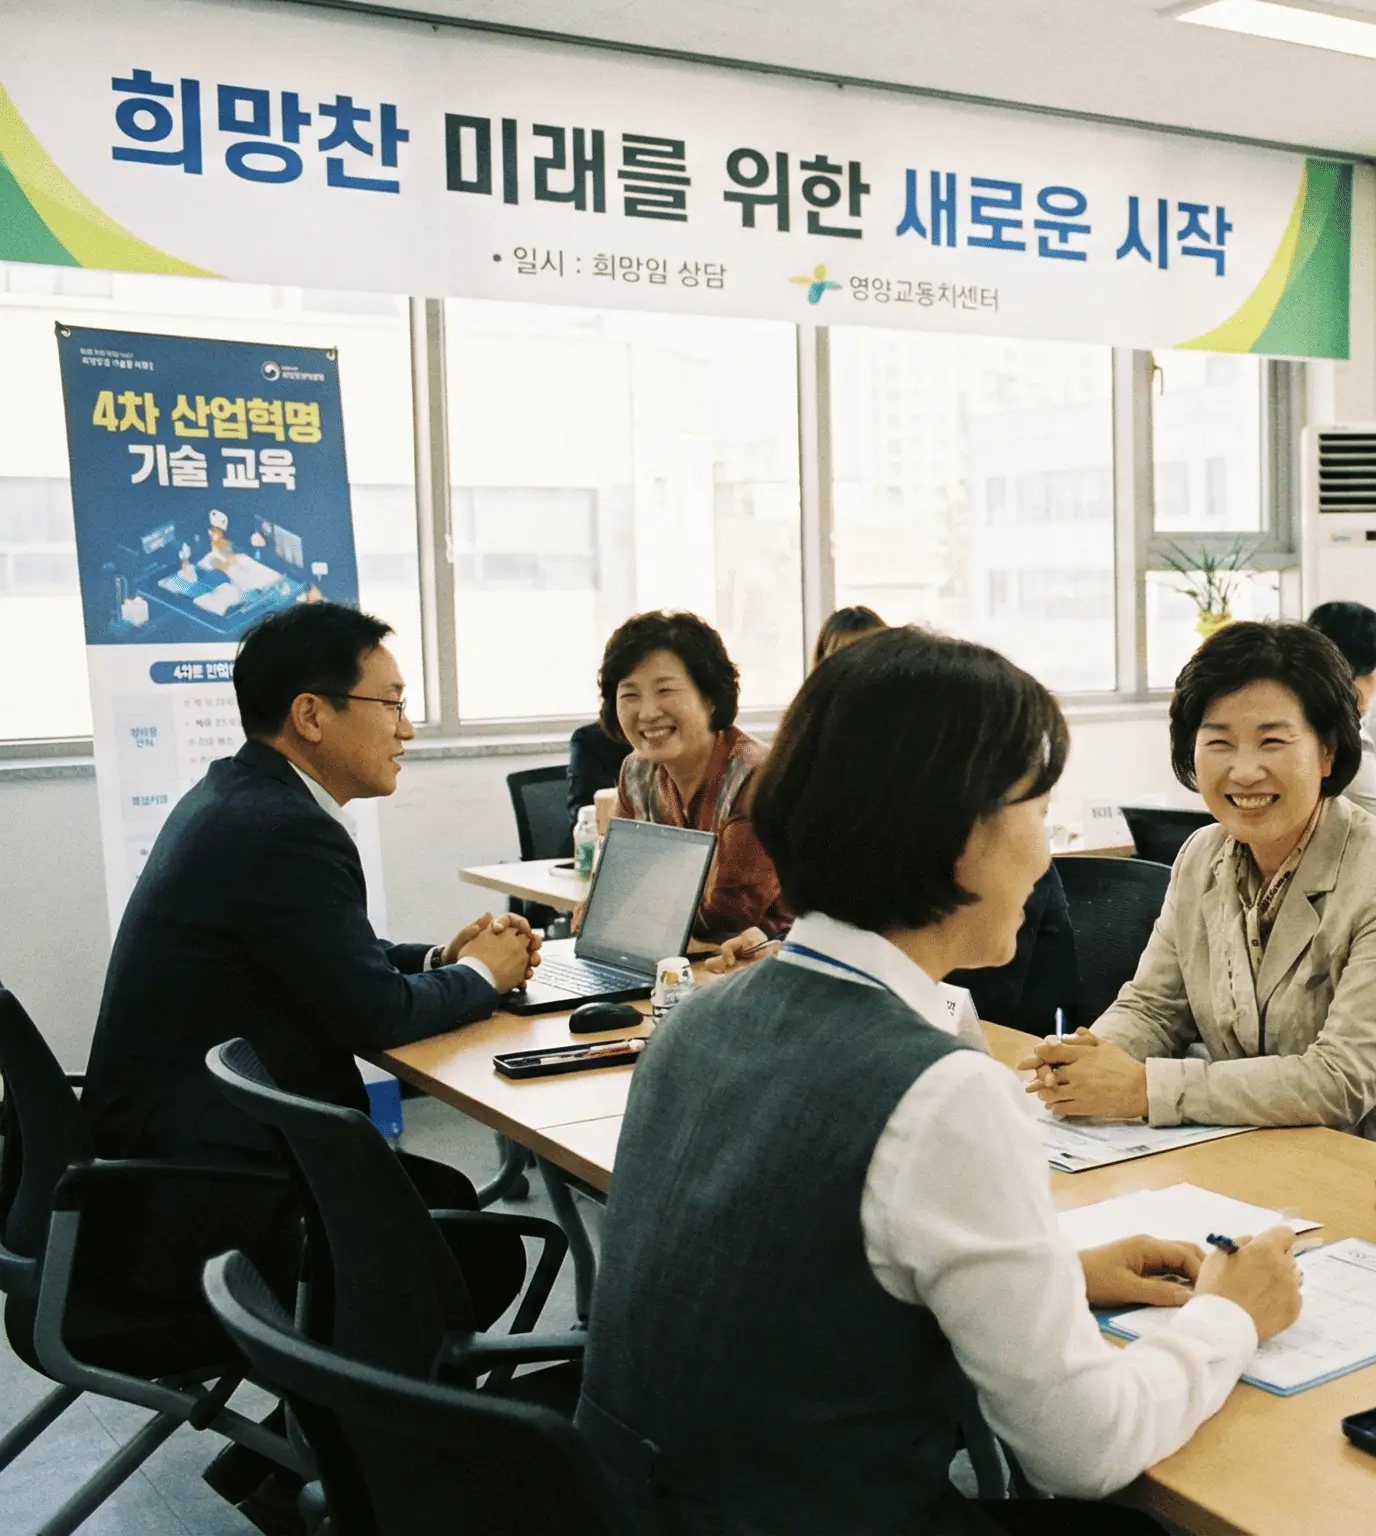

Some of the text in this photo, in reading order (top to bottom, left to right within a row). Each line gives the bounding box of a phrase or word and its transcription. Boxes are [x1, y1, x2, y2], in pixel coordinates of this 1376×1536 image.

[111, 68, 1233, 277] 희망찬 미래를 위한 새로운 시작
[513, 246, 564, 277] 일시
[678, 260, 727, 289] 상담
[92, 390, 322, 444] 4차 산업혁명
[127, 444, 296, 491] 기술 교육
